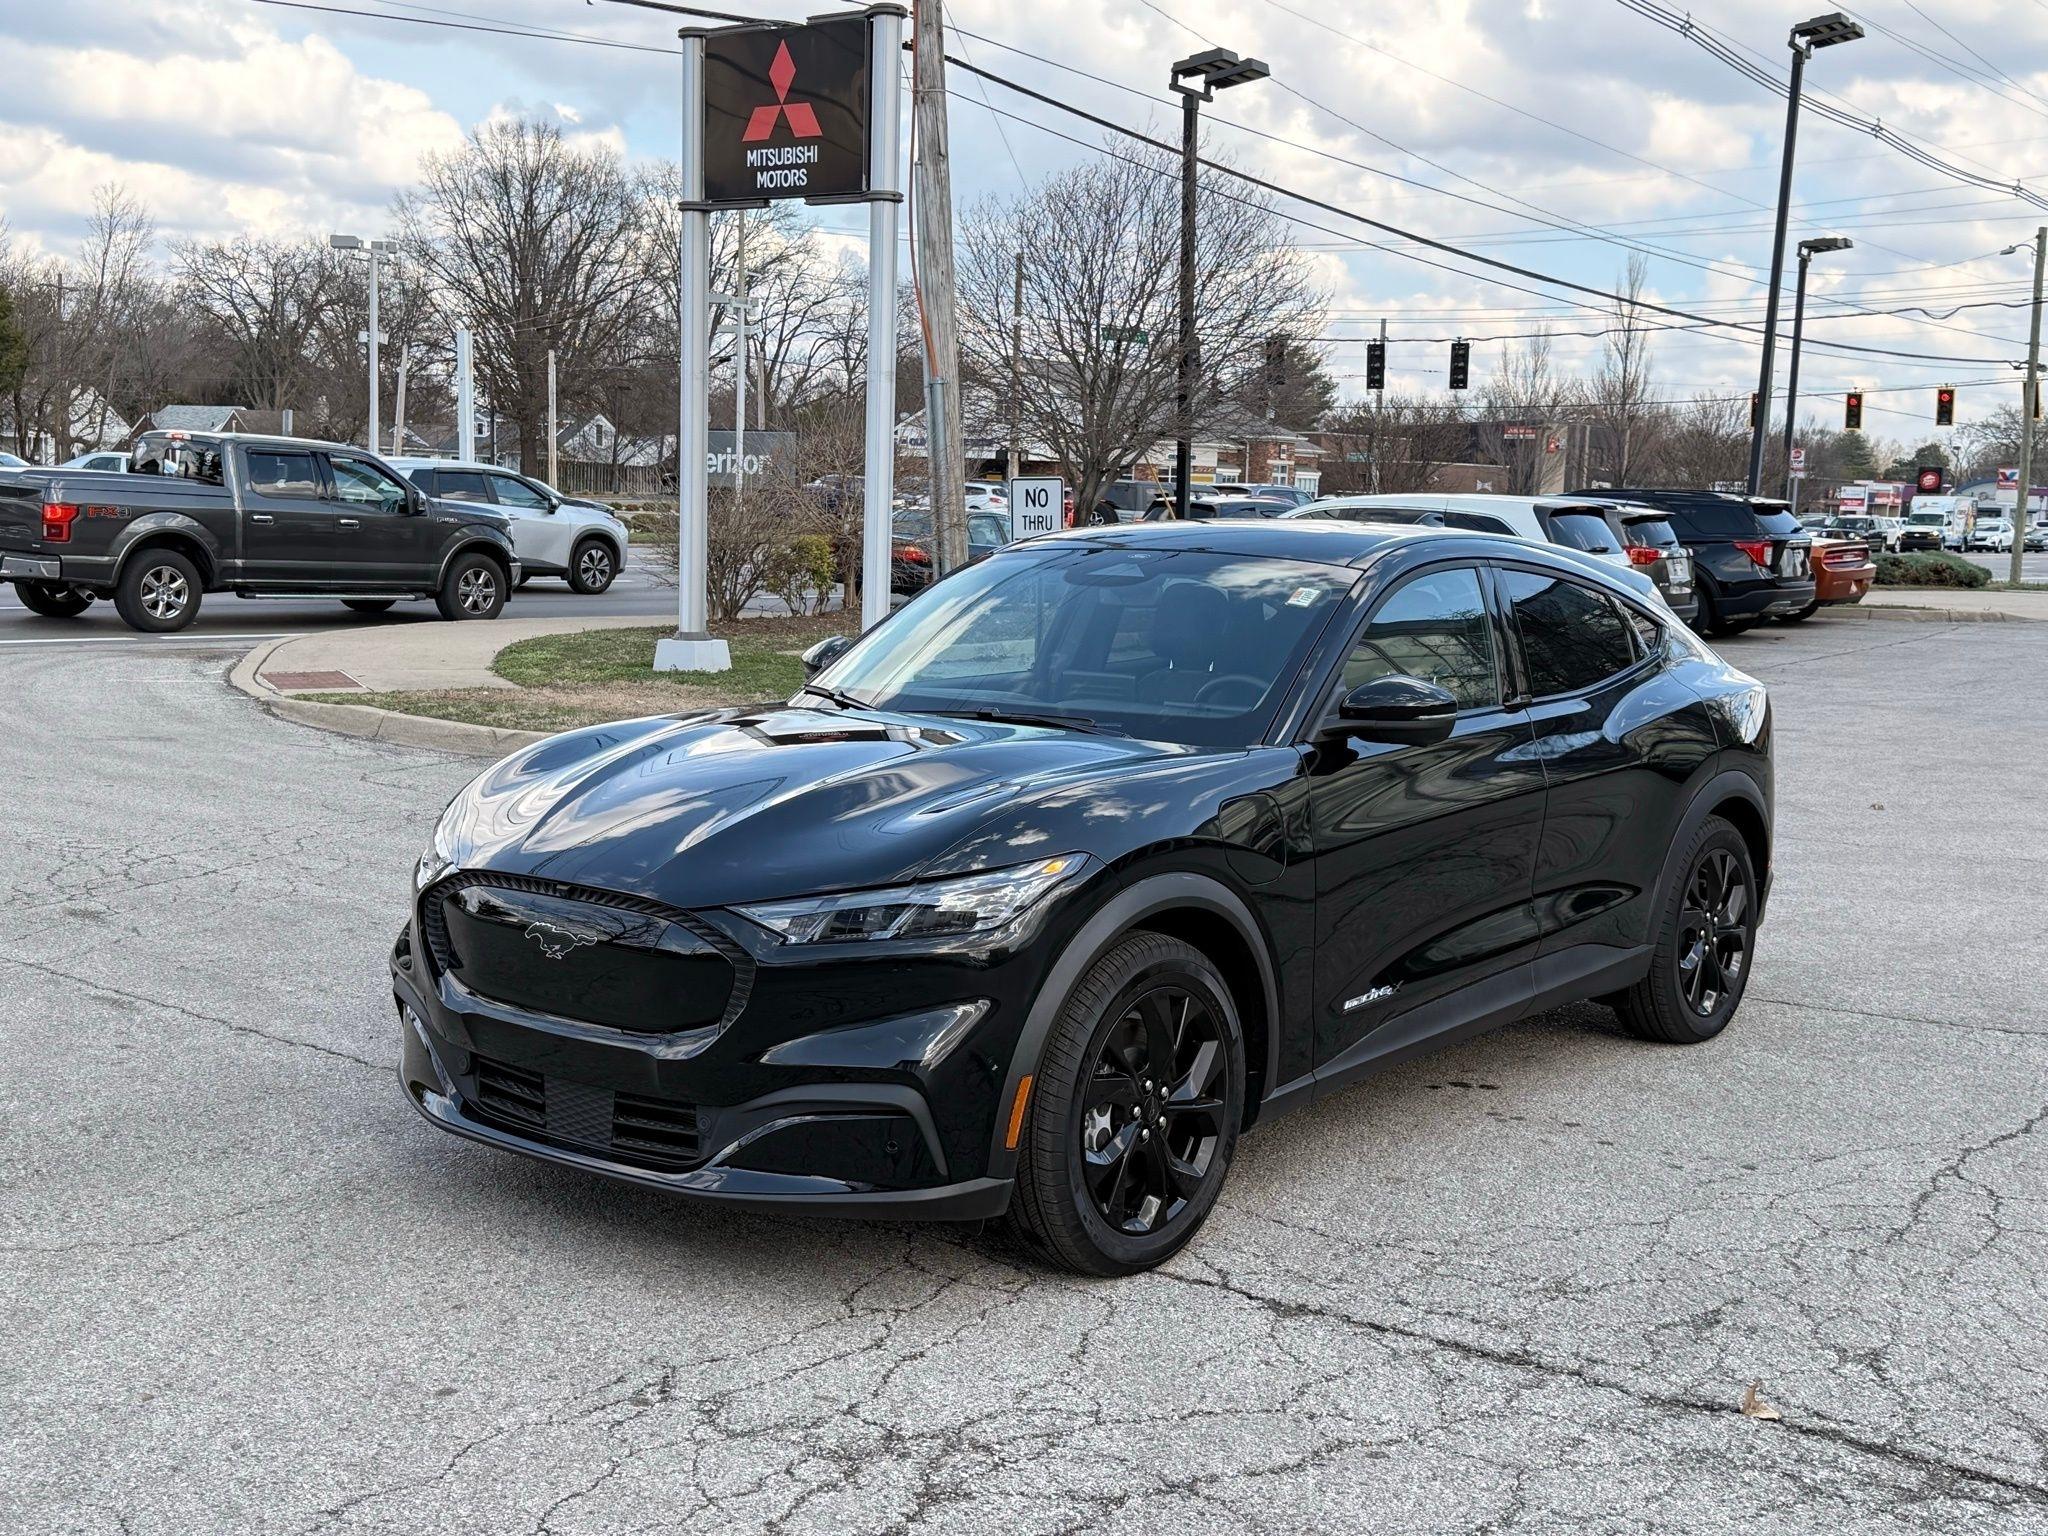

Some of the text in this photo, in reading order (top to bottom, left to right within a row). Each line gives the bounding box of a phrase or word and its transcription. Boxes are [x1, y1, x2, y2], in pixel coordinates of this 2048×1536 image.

[746, 145, 818, 167] MITSUBISHI
[756, 168, 808, 188] MOTORS
[707, 446, 773, 475] erizon
[1025, 488, 1049, 508] NO
[1022, 514, 1053, 531] THRU
